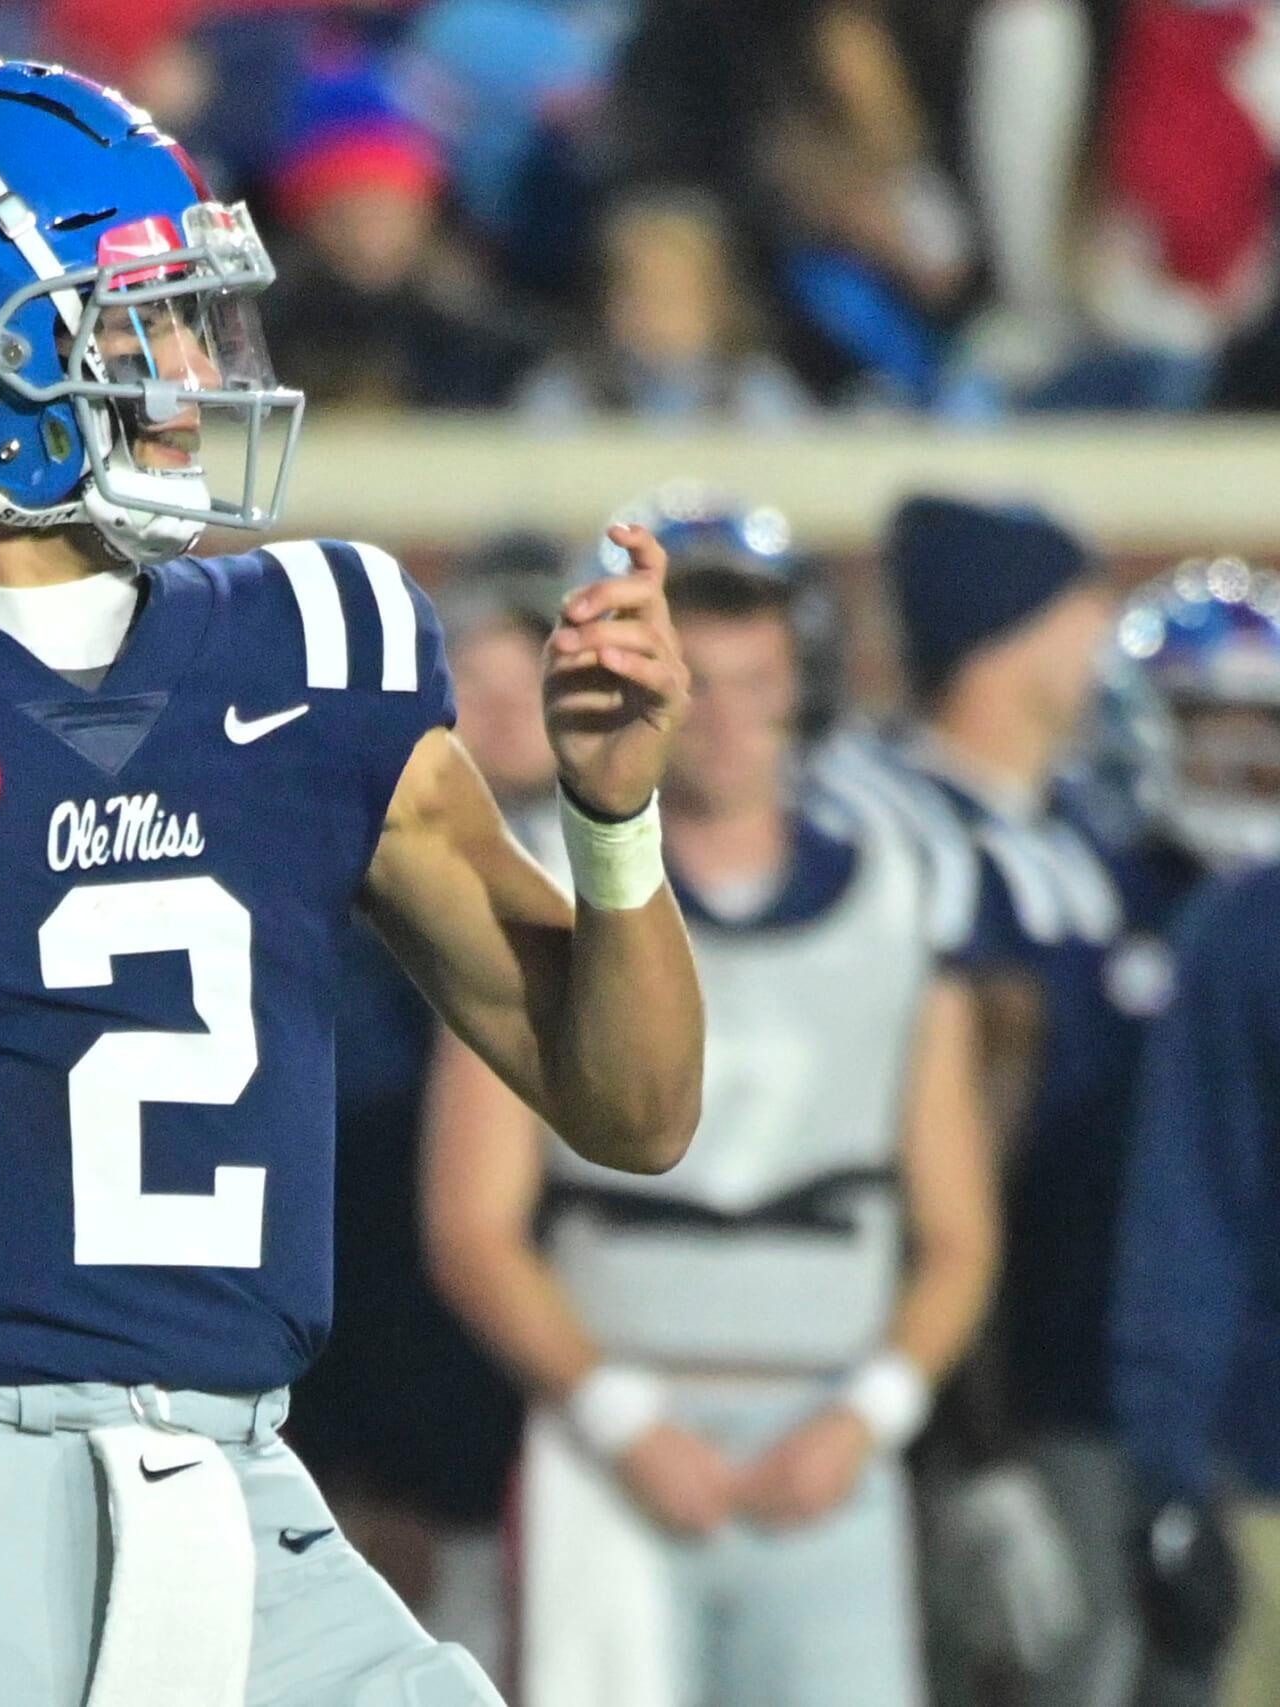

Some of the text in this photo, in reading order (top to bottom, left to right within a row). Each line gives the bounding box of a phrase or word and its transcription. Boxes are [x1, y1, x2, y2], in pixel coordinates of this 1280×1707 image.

[47, 792, 206, 872] Ole Miss
[38, 875, 267, 1269] 2
